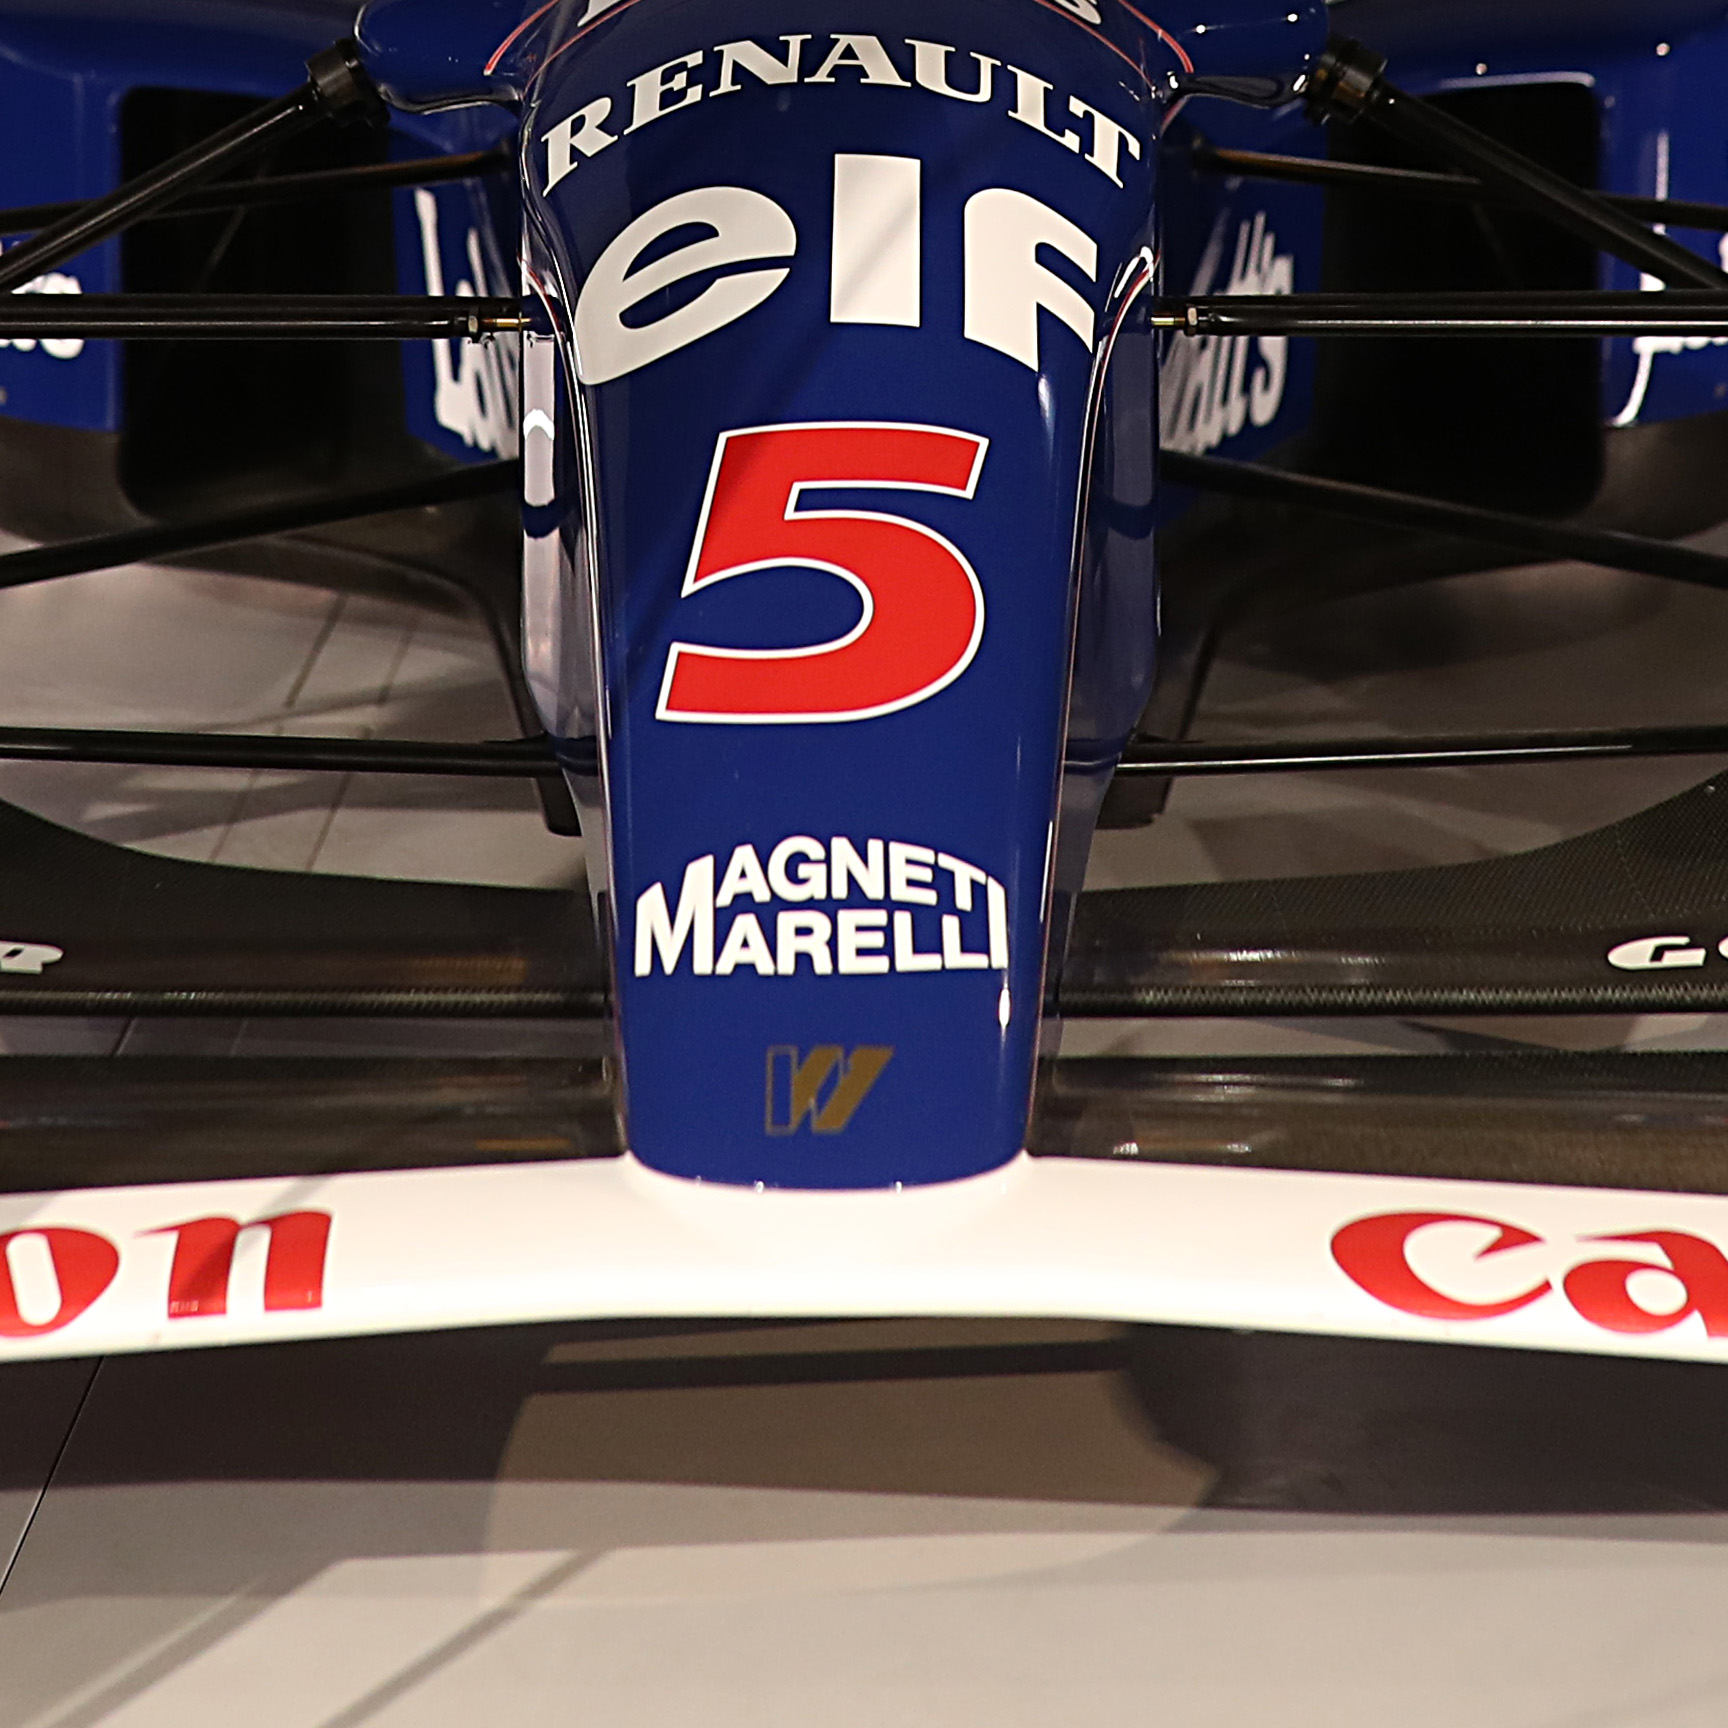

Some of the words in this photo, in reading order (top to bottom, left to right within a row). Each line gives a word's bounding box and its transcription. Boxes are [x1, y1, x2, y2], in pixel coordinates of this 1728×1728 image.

[541, 32, 1142, 196] RENAULT
[574, 152, 1099, 386] elf
[654, 420, 991, 724] 5
[634, 835, 1009, 930] MAGNETI
[634, 884, 1009, 977] MARELLI
